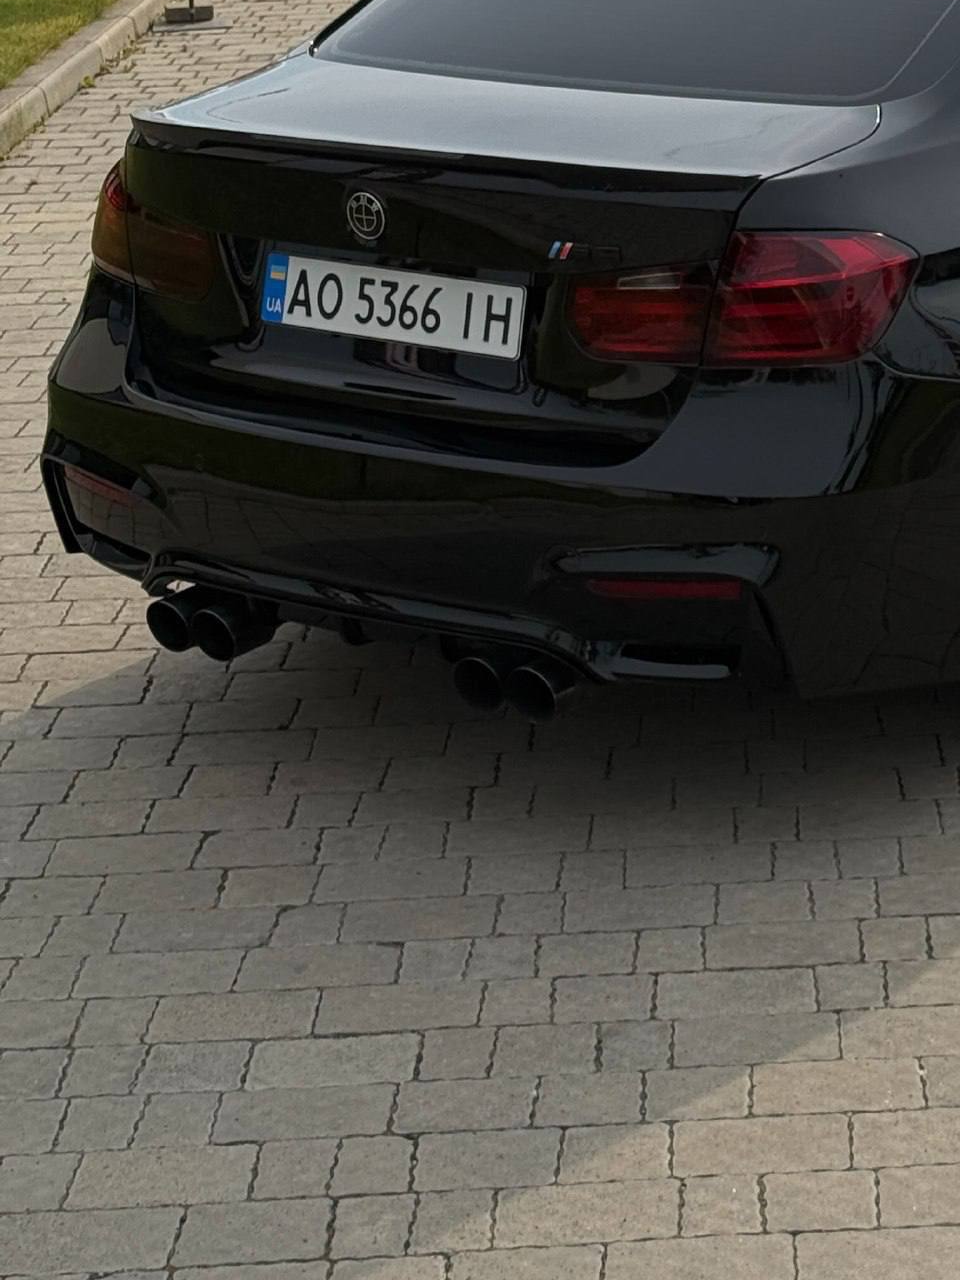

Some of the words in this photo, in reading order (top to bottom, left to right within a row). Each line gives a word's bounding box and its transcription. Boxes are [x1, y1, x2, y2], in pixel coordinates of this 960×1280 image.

[266, 298, 282, 314] UA
[287, 269, 343, 320] AO
[354, 277, 443, 333] 5366
[463, 291, 513, 345] IH
